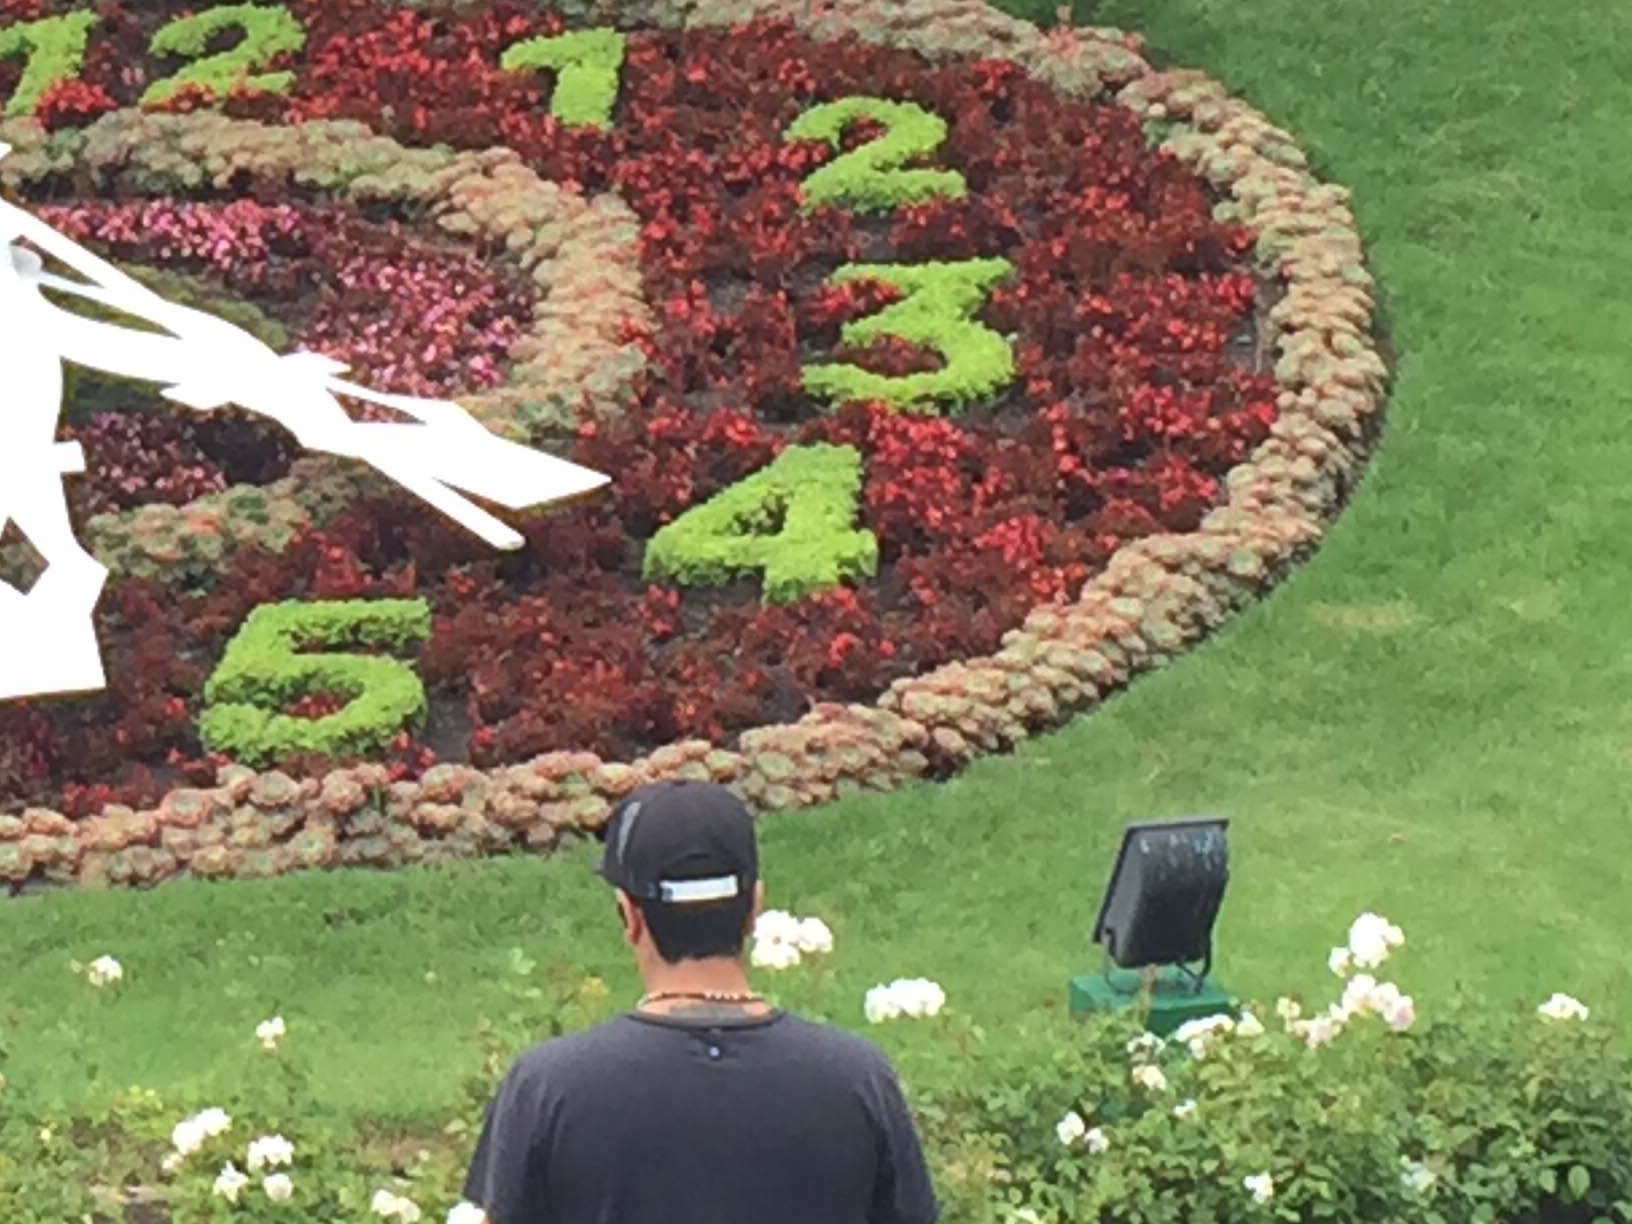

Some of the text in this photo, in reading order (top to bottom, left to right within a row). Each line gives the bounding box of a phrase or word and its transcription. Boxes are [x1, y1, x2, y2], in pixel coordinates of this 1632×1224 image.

[501, 27, 626, 130] 1
[784, 96, 967, 216] 2
[801, 256, 1013, 416] 3
[643, 442, 878, 604] 4
[200, 597, 431, 766] 5
